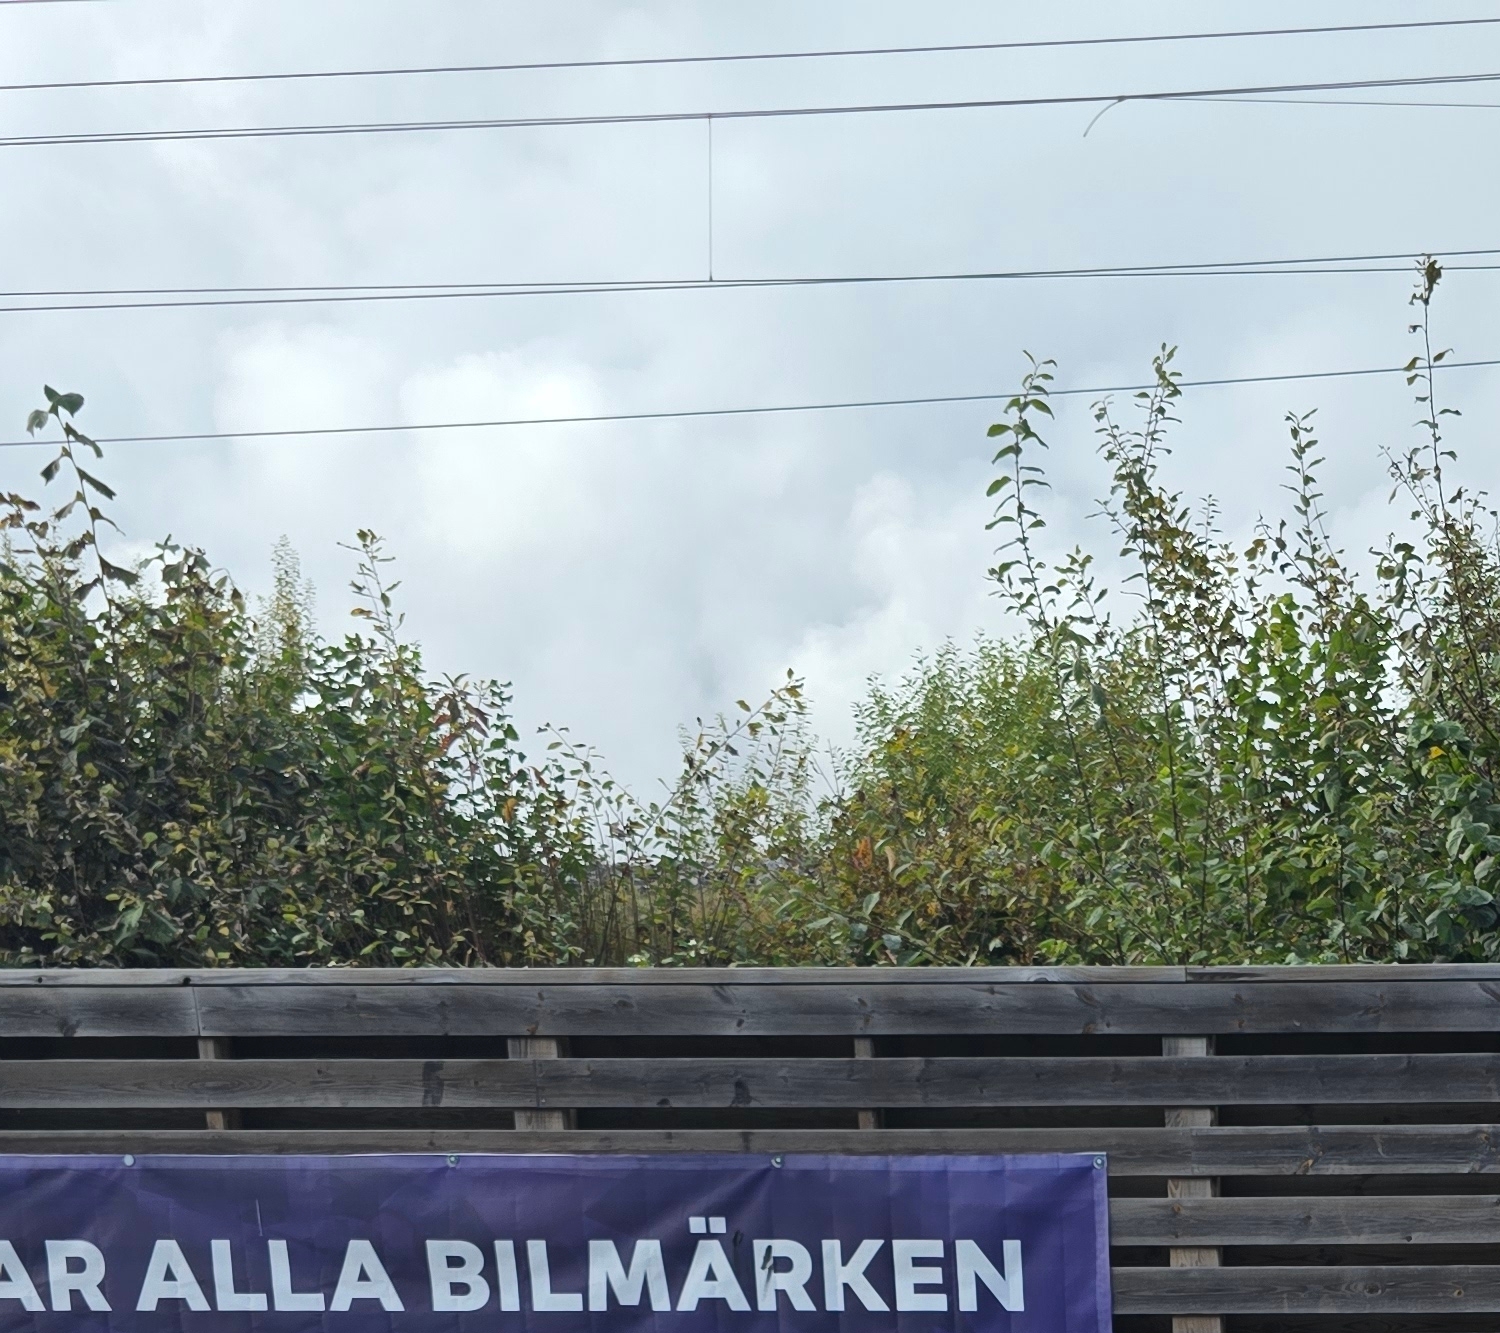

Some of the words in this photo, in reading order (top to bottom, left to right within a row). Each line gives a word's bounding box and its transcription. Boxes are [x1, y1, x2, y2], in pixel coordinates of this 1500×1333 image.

[0, 1239, 113, 1312] AR
[136, 1239, 405, 1312] ALLA
[425, 1216, 1025, 1312] BILMÄRKEN
